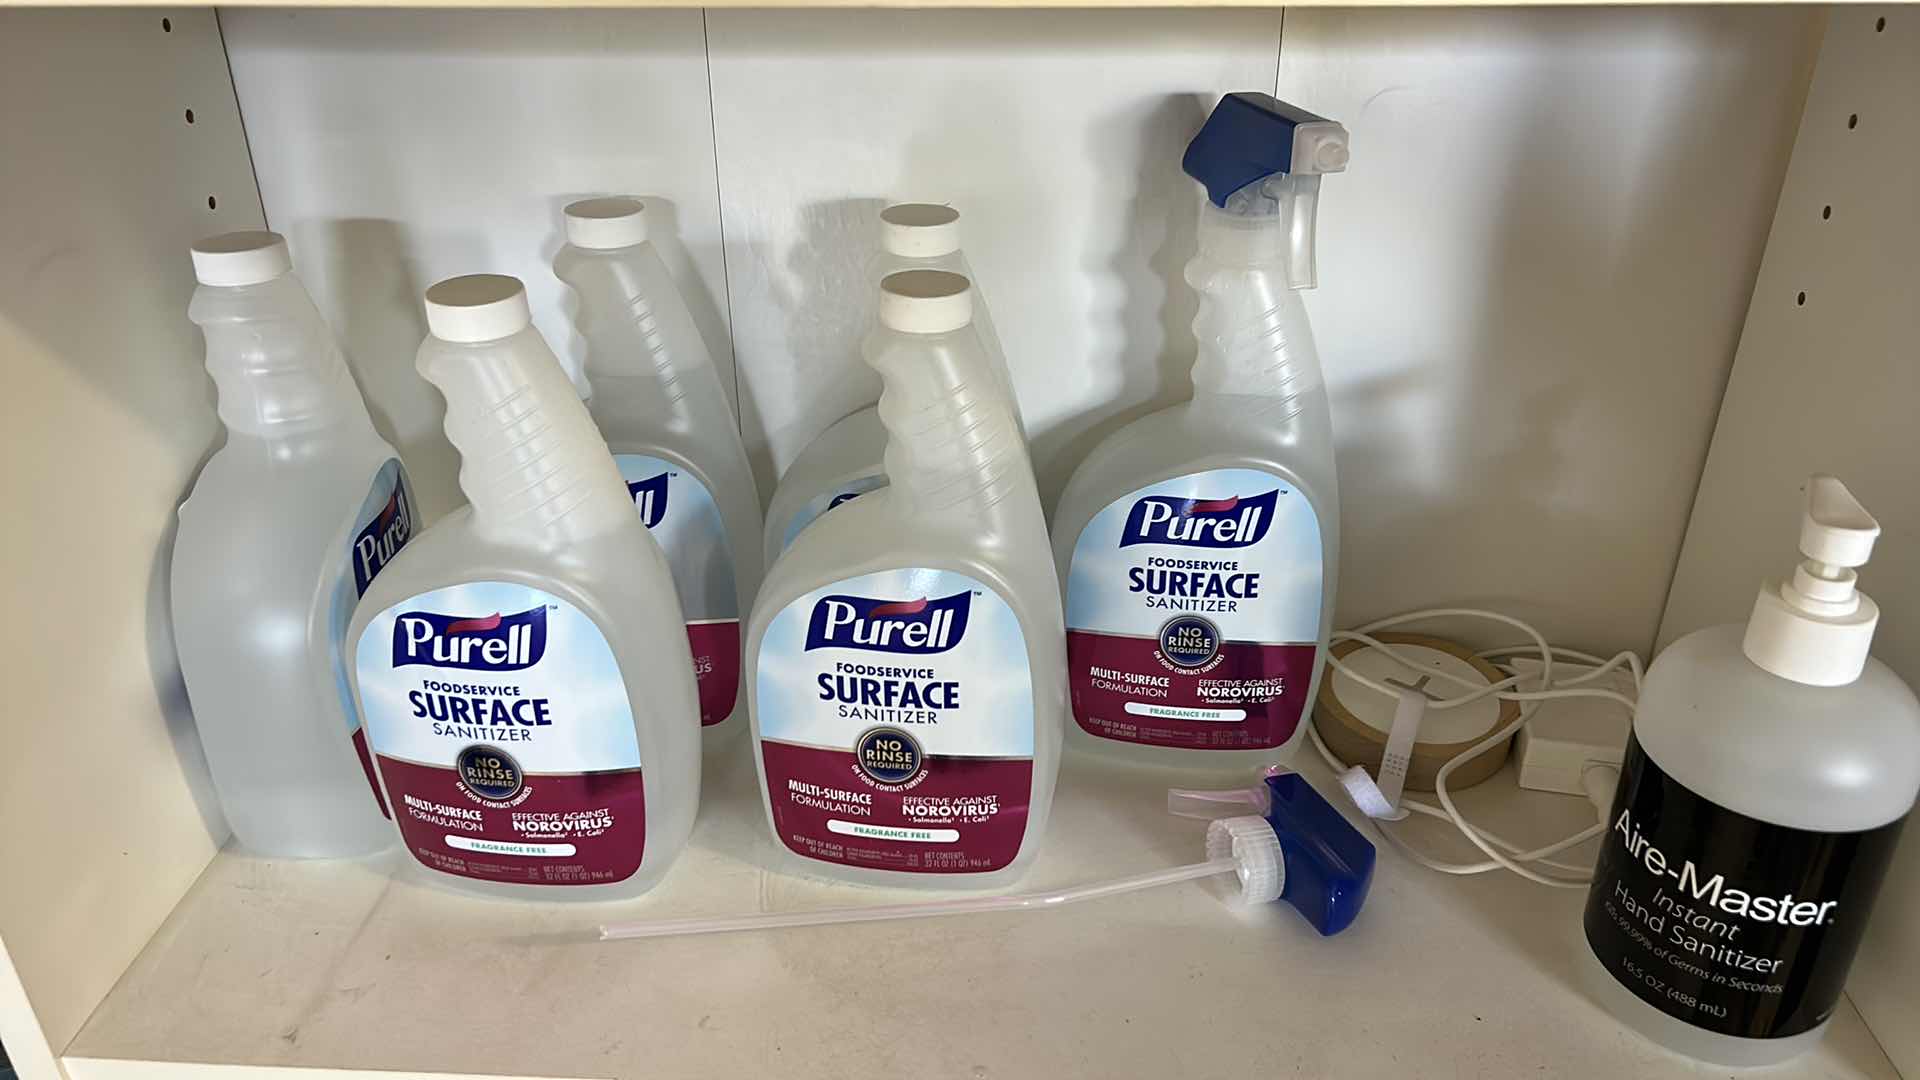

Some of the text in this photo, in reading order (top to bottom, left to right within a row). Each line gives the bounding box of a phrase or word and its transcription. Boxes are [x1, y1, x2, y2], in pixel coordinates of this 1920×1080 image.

[1139, 500, 1262, 542] Purell
[357, 493, 410, 582] Purell
[1148, 557, 1238, 571] FOODSERVICE
[1129, 567, 1260, 598] SURFACE
[1146, 595, 1237, 612] SANITIZER
[824, 599, 954, 648] Purell
[1178, 627, 1202, 637] NO
[401, 617, 532, 664] Purell
[1168, 636, 1211, 648] RINSE
[1168, 646, 1209, 655] REQUIRED
[836, 662, 934, 679] FOODSERVICE
[1090, 666, 1169, 687] MULTI-SURFACE
[423, 680, 520, 696] FOODSERVICE
[1091, 678, 1168, 698] FORMULATION
[1198, 677, 1284, 687] EFFECTIVE AGAINST
[817, 673, 960, 709] SURFACE
[408, 690, 552, 726] SURFACE
[839, 704, 937, 724] SANITIZER
[1150, 708, 1199, 718] FRAGRANCE
[433, 722, 532, 741] SANITIZER
[876, 740, 901, 751] NO
[475, 756, 500, 769] NO
[866, 749, 912, 763] RINSE
[466, 766, 514, 780] RINSE
[867, 761, 912, 770] REQUIRED
[469, 777, 515, 788] REQUIRED
[789, 779, 872, 805] MULTI-SURFACE
[903, 795, 997, 806] EFFECTIVE AGAINST
[404, 794, 483, 821] MULTI-SURFACE
[791, 793, 871, 816] FORMULATION
[408, 807, 484, 832] FORMULATION
[512, 808, 609, 822] EFFECTIVE AGAINST
[854, 826, 908, 838] FRAGRANCE
[470, 841, 547, 854] FRAGRANCE FREE
[1652, 887, 1740, 940] Instant
[1614, 879, 1783, 974] Hand Sanitizer
[1653, 946, 1670, 959] of
[1668, 954, 1710, 980] Germs
[1711, 972, 1726, 984] in
[1645, 975, 1665, 992] OZ
